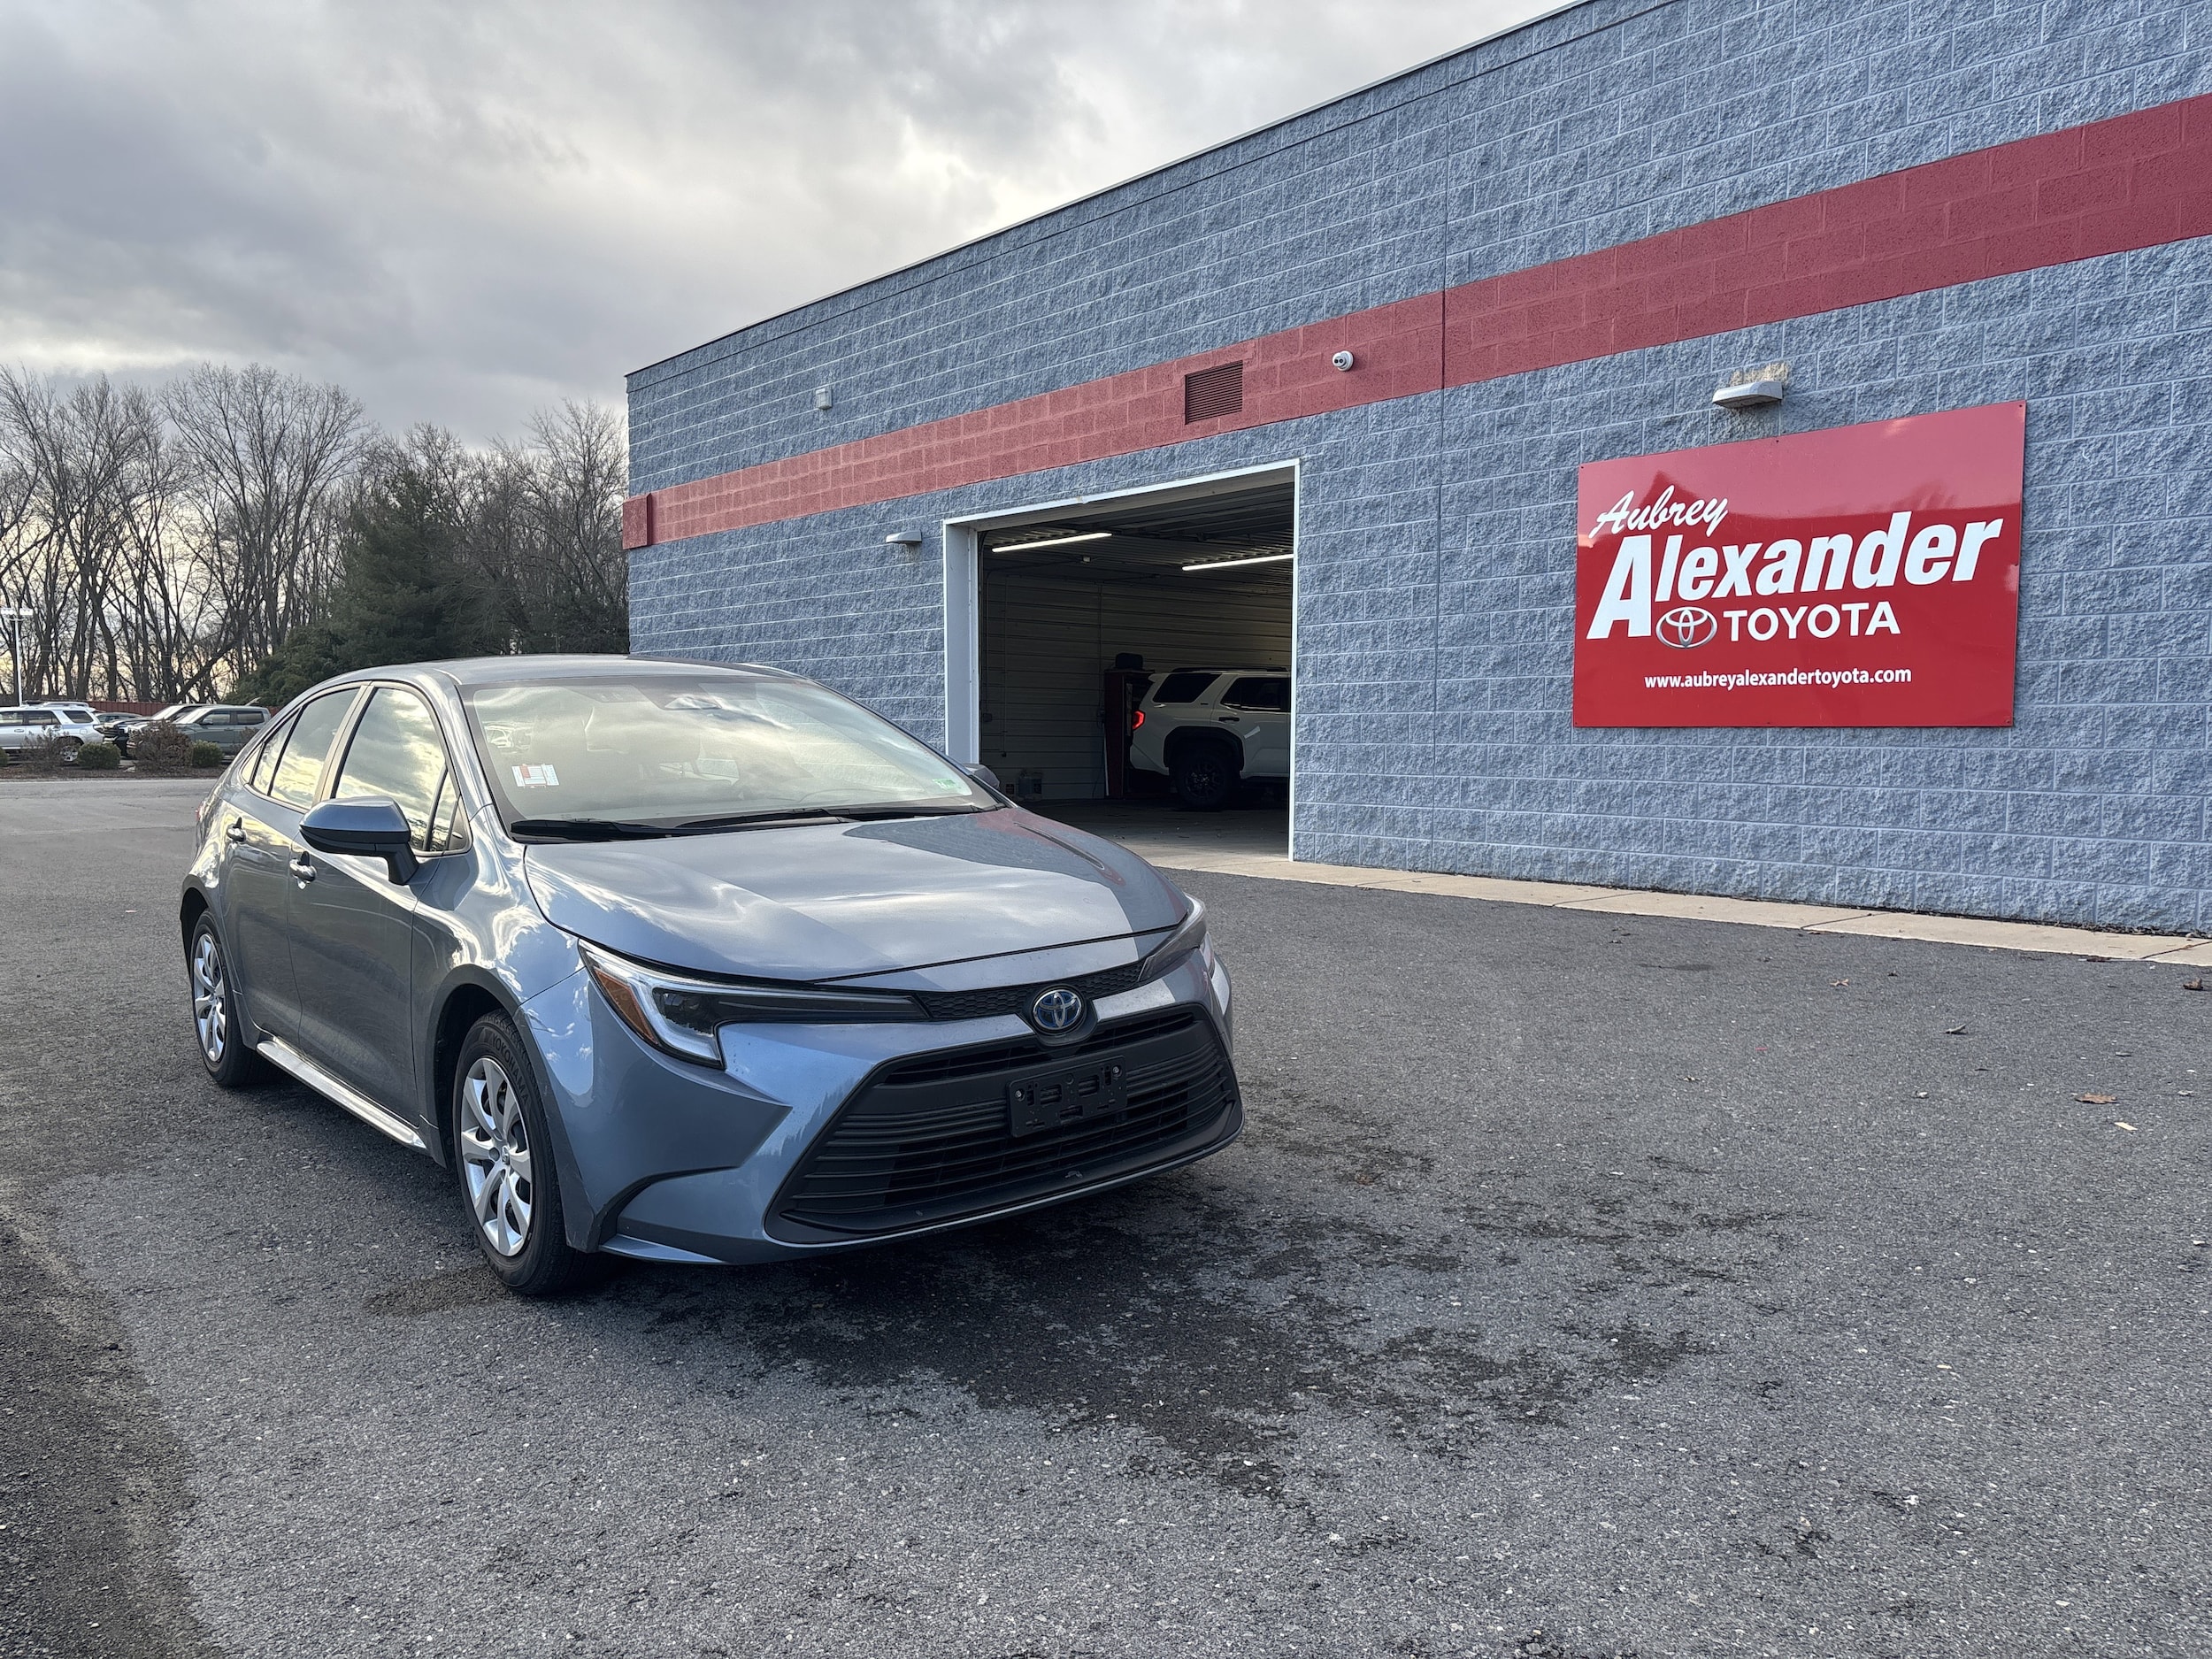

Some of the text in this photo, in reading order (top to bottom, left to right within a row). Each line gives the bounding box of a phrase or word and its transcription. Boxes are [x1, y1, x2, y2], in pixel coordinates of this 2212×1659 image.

[1587, 485, 1729, 538] Aubrey
[1586, 511, 2003, 640] Alexander
[1724, 601, 1901, 641] TOYOTA
[1644, 667, 1912, 690] www.aubreyalexandertoyota.com
[492, 1033, 529, 1103] YOKOHAMA
